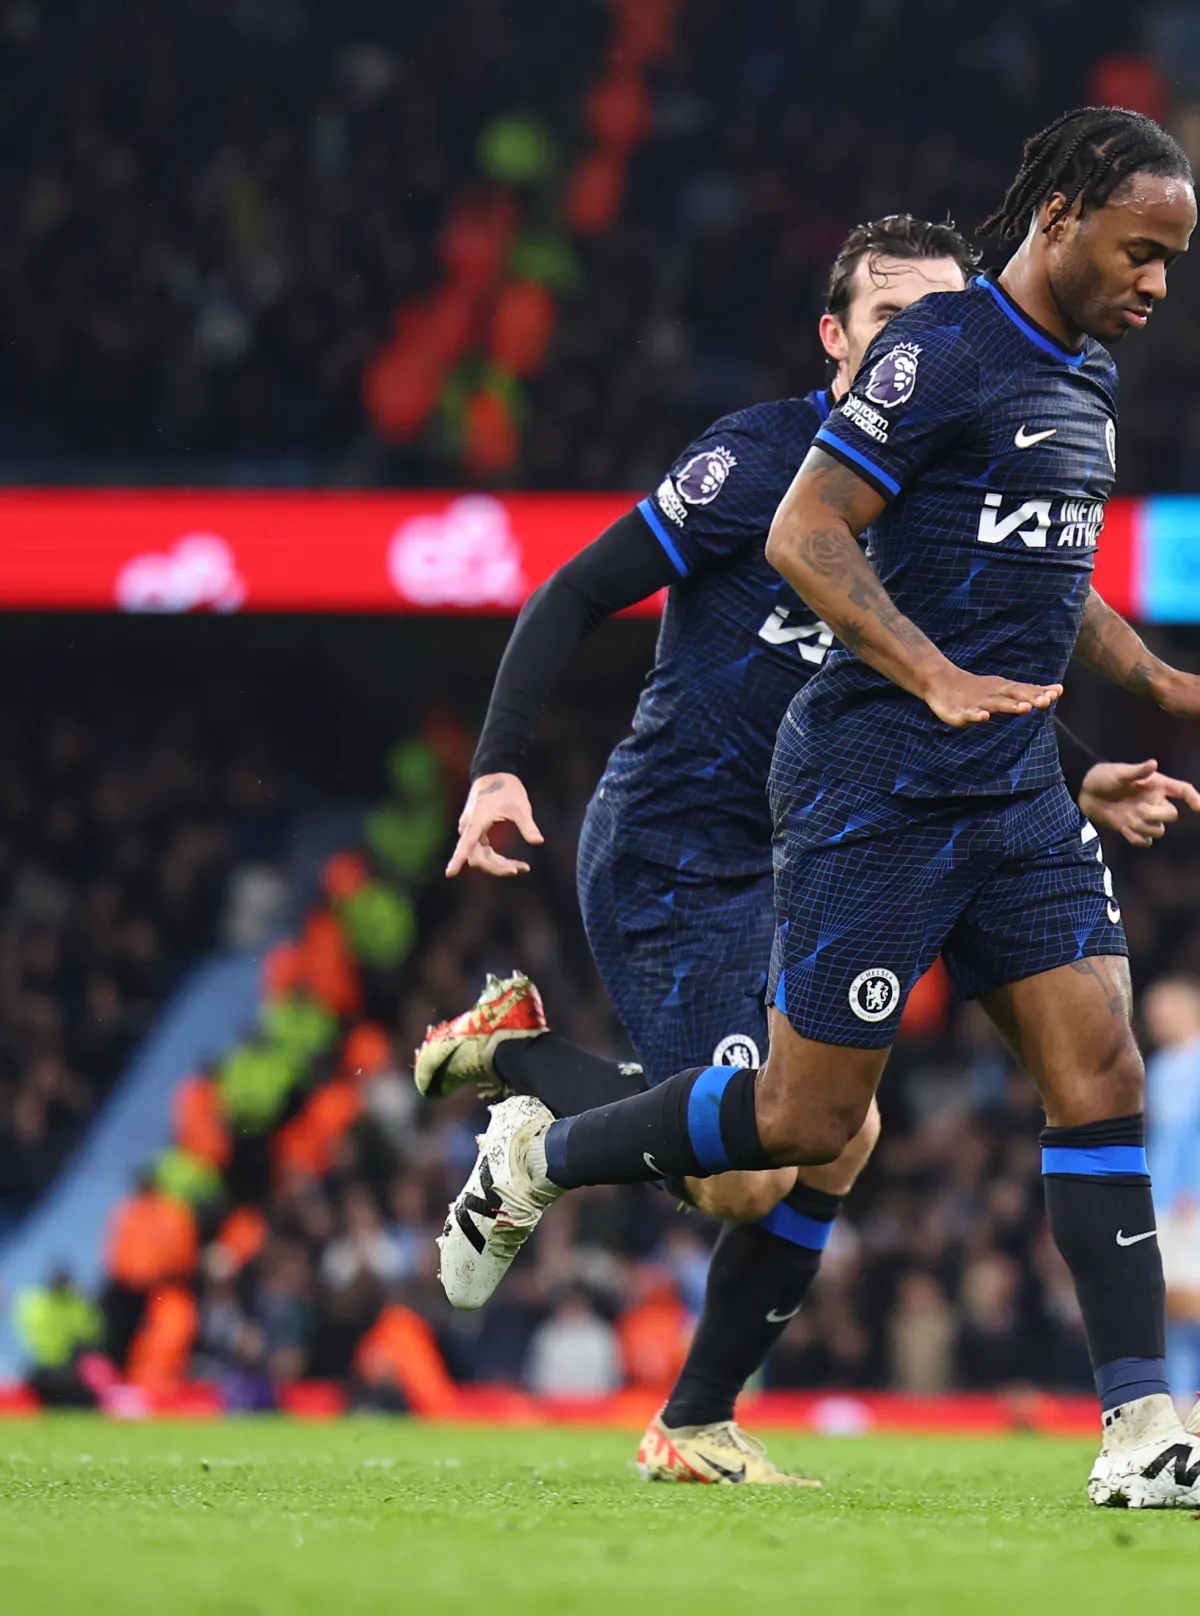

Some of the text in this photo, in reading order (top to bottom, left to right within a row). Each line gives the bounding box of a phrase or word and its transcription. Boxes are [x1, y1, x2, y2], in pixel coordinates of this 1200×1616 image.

[851, 413, 888, 443] racism
[859, 405, 889, 430] room
[860, 970, 893, 981] CHELSEA
